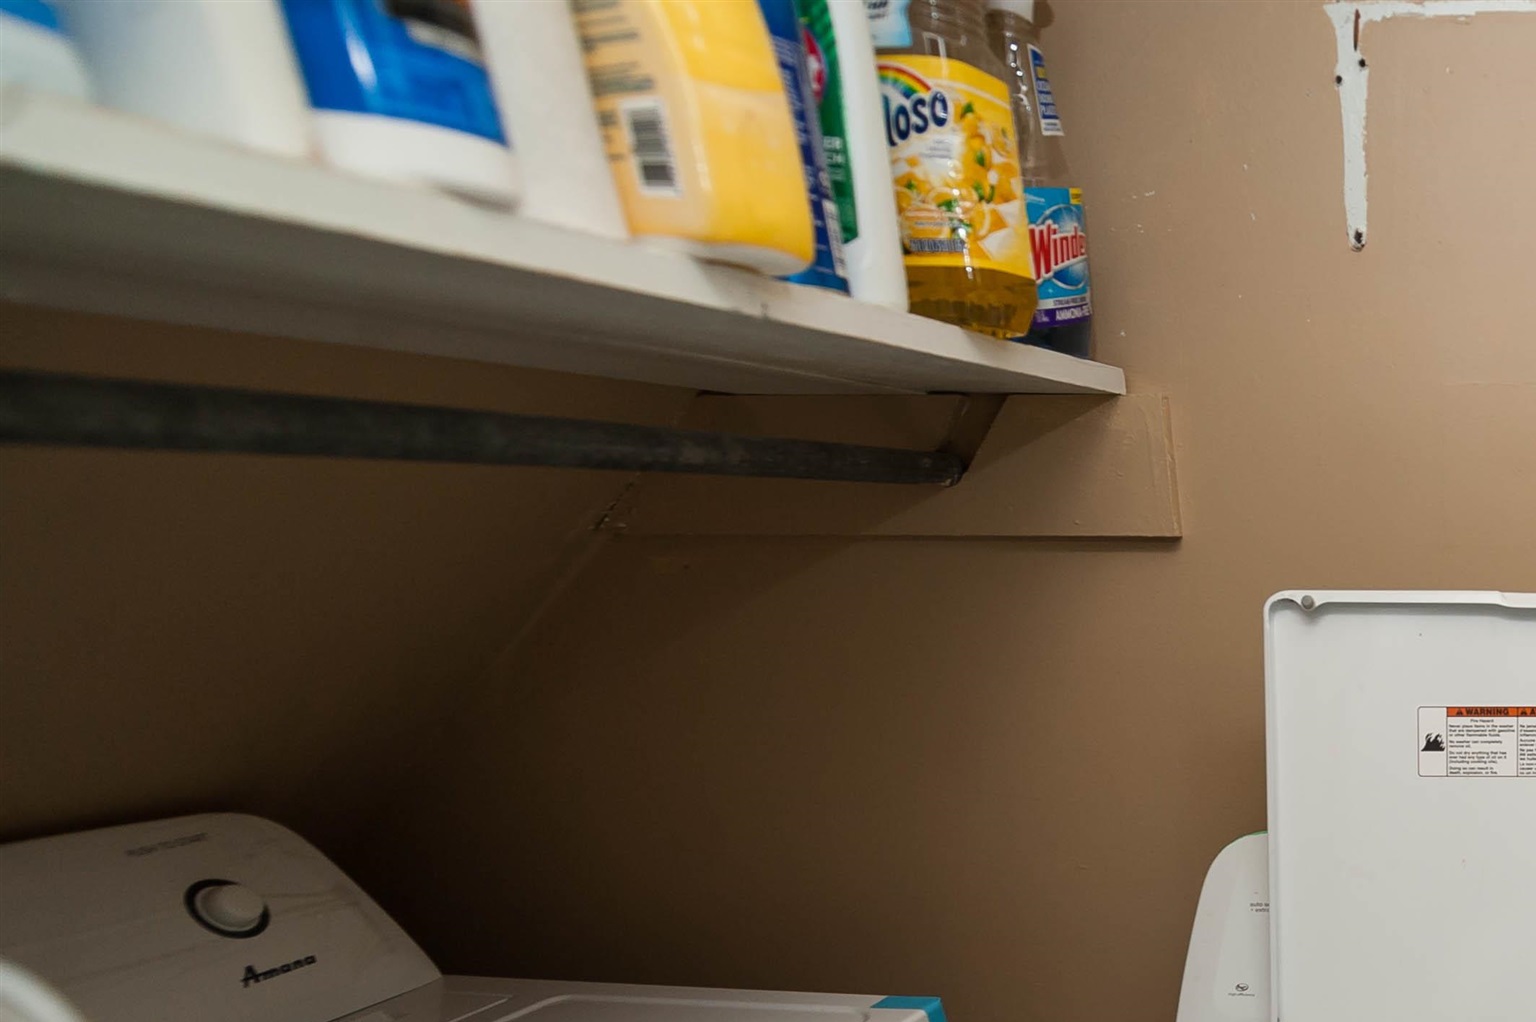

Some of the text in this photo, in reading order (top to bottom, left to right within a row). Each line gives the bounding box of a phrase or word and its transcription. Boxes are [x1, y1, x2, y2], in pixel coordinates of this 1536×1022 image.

[881, 91, 948, 147] loso
[1028, 222, 1087, 281] Winde
[1465, 707, 1509, 716] WARNING
[240, 954, 317, 988] Amana
